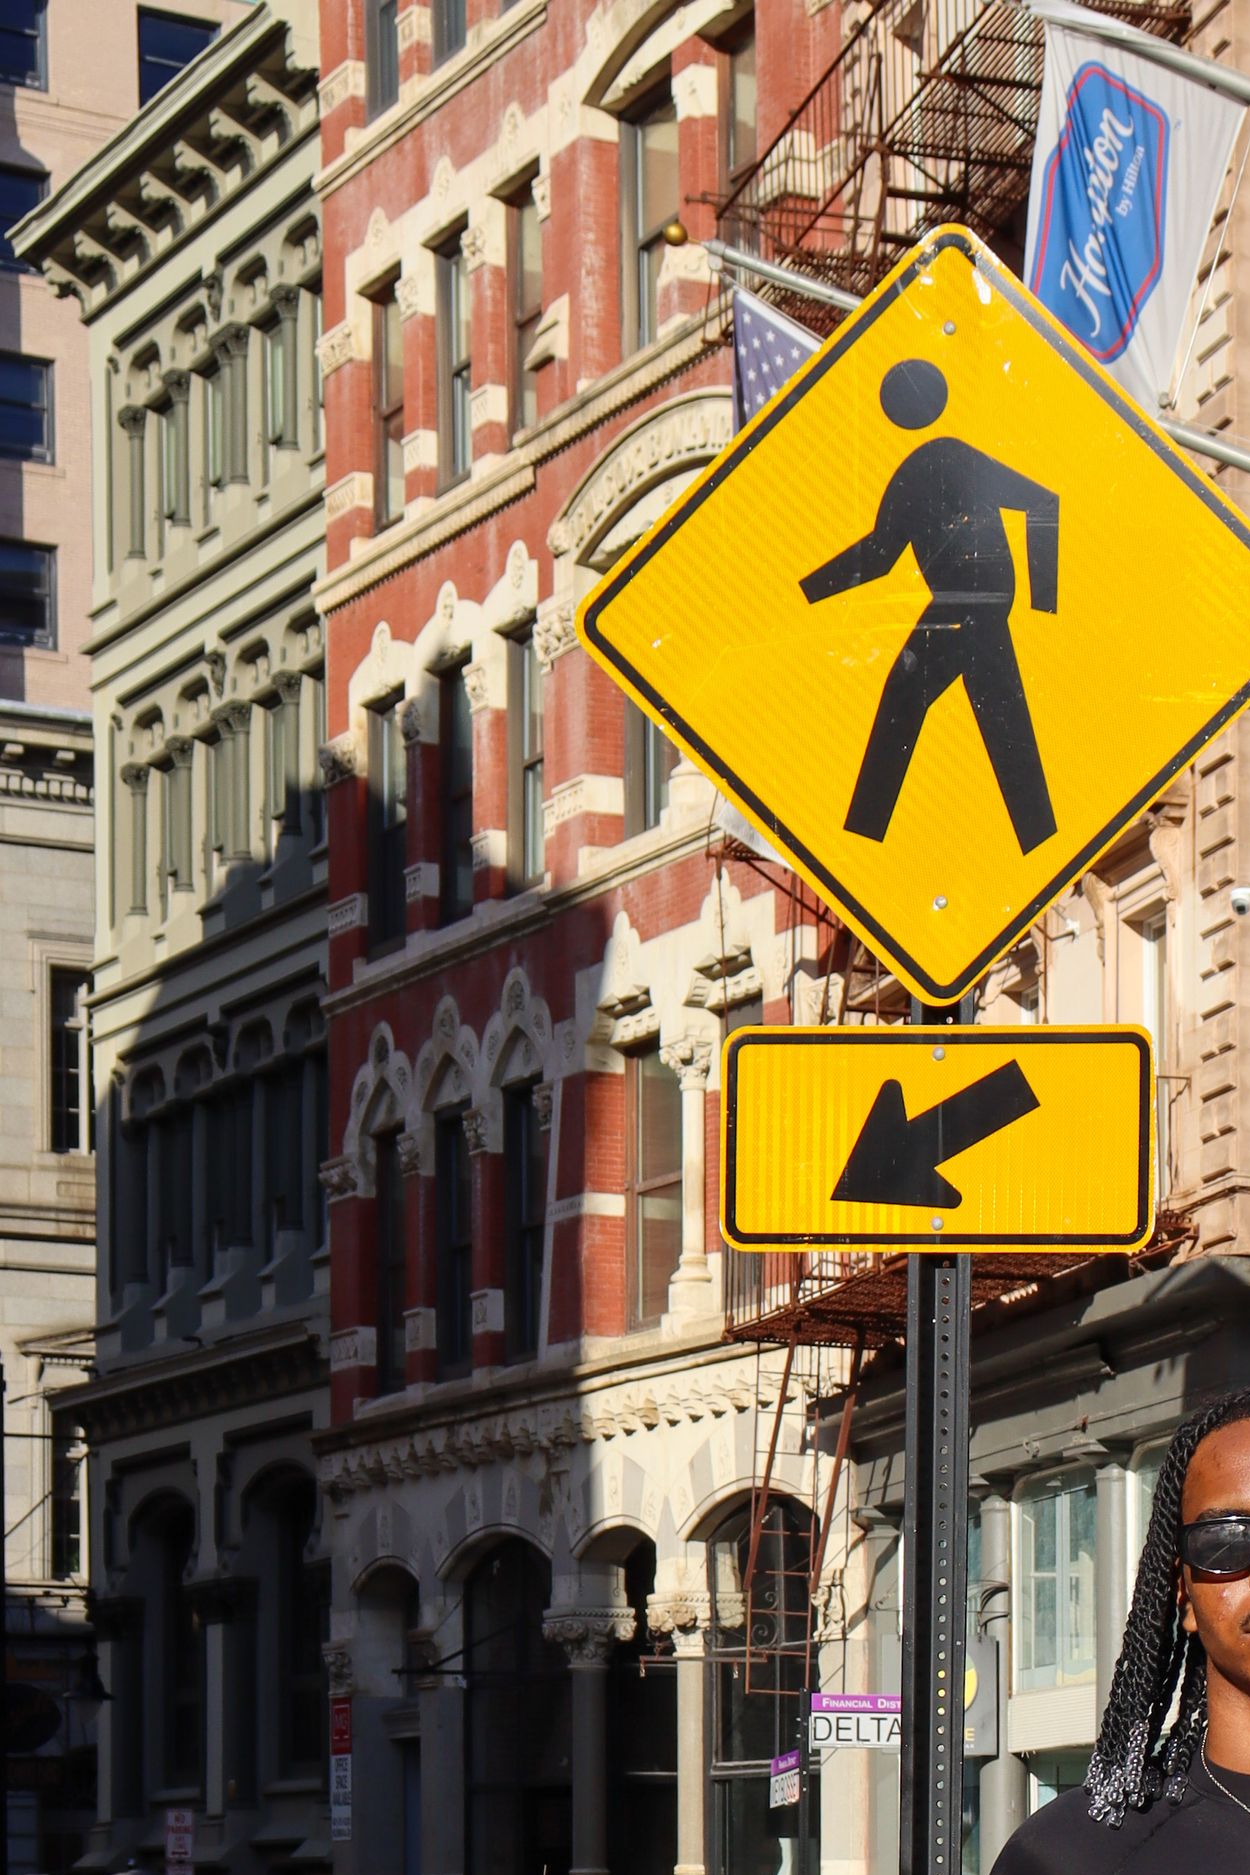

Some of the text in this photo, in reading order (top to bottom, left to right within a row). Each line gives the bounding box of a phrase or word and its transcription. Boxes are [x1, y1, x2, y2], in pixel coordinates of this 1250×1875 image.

[1115, 145, 1145, 218] by Hilton
[822, 1698, 873, 1708] FINANCIAL
[813, 1716, 901, 1742] DELTA
